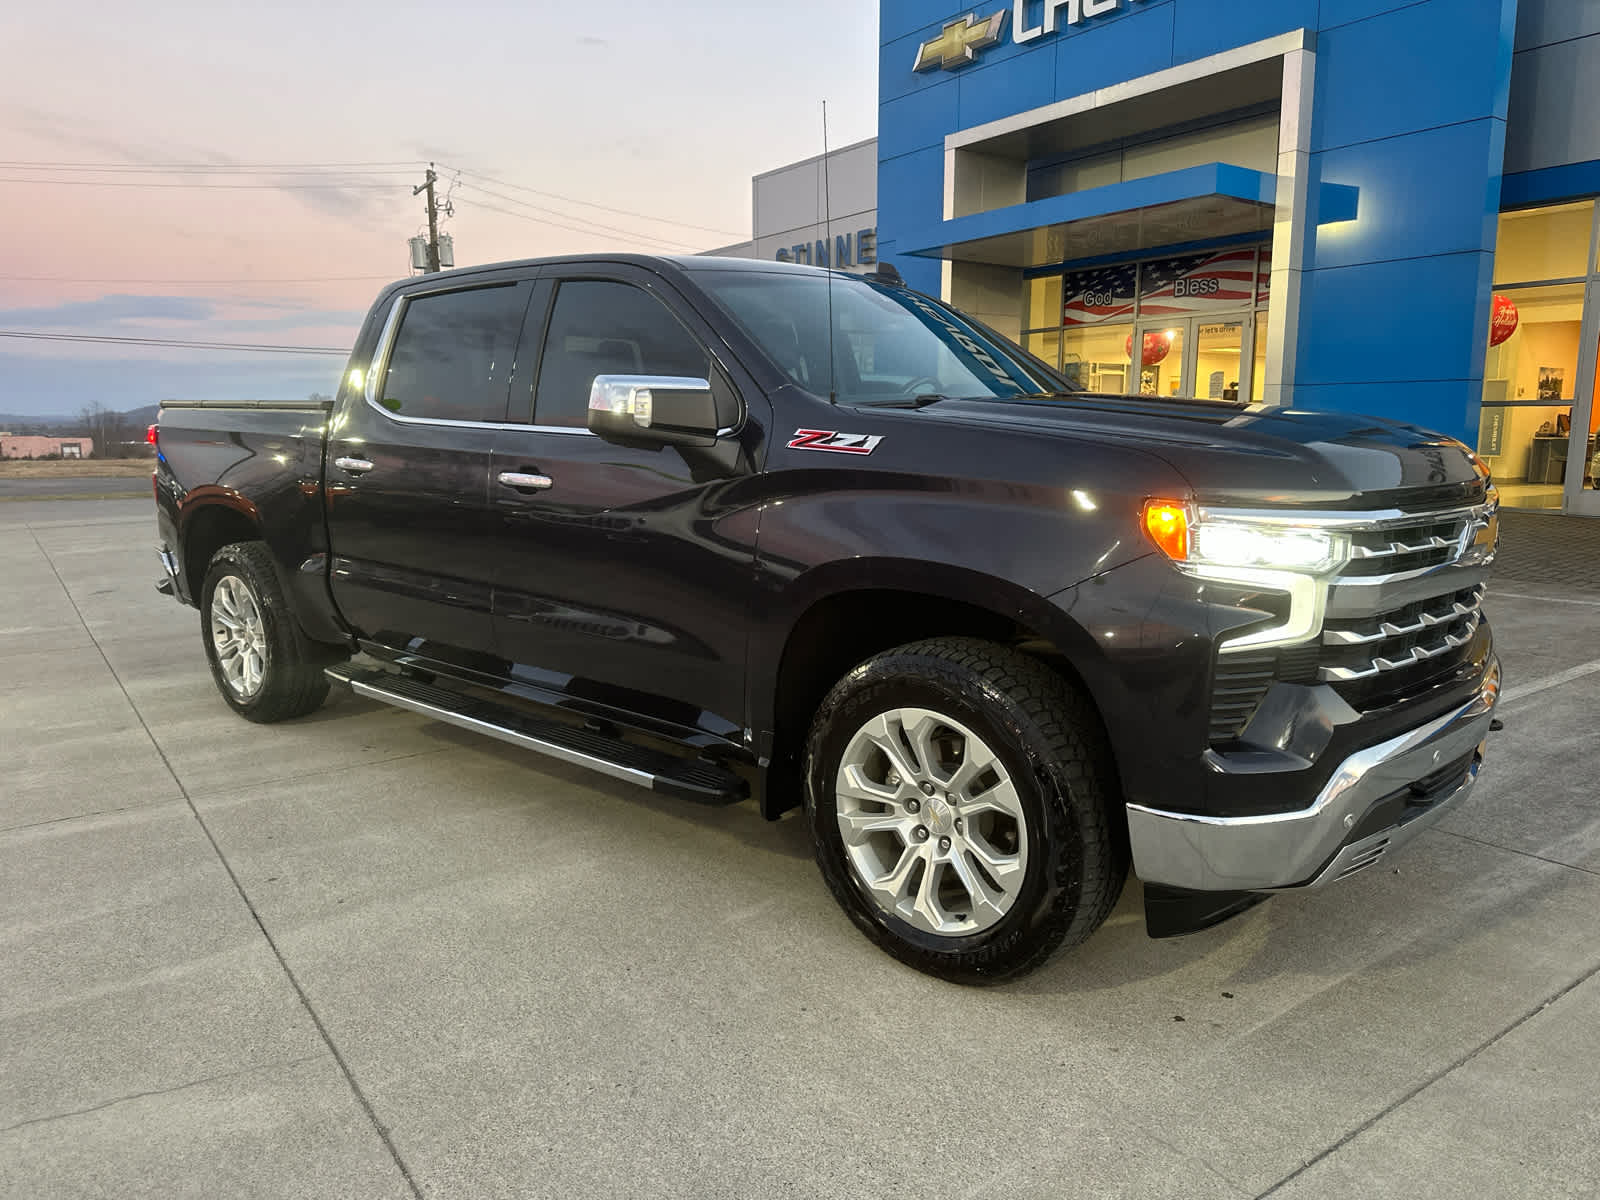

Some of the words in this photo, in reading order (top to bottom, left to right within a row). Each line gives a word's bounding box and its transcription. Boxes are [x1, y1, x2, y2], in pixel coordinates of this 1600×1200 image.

[1083, 289, 1112, 307] God
[1173, 278, 1220, 297] Bless
[785, 428, 887, 455] Z71
